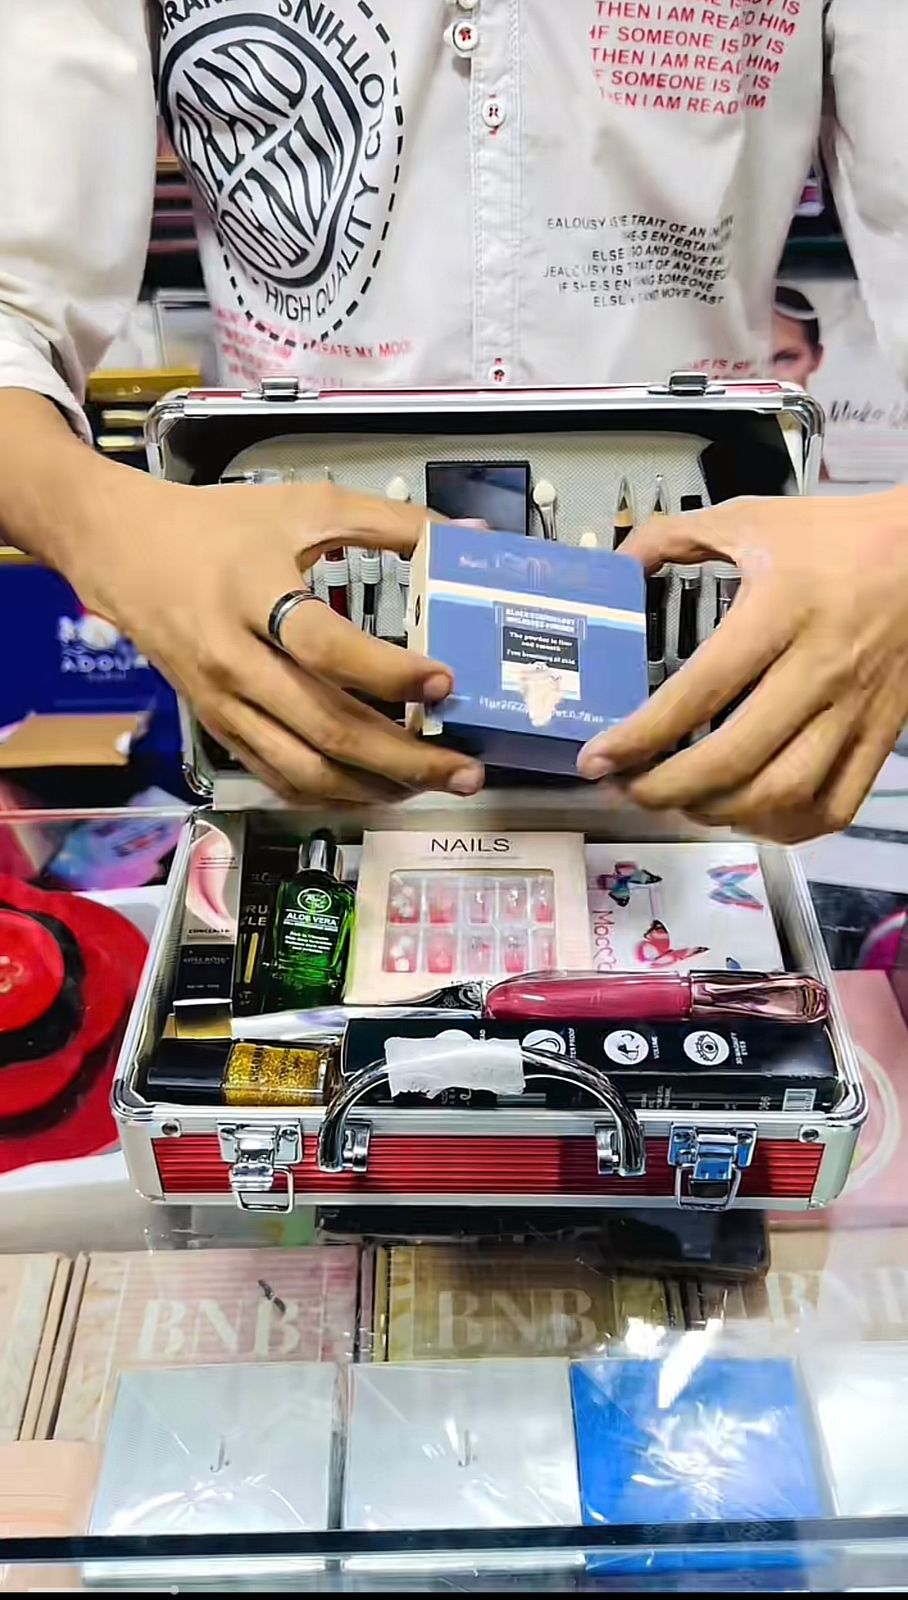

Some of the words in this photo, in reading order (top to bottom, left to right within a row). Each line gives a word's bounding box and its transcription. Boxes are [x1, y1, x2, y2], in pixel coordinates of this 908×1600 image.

[595, 0, 650, 19] THEN
[657, 5, 661, 20] I
[668, 6, 695, 22] AM
[759, 12, 795, 36] HIM
[618, 26, 713, 49] SOMEONE
[721, 38, 738, 53] IS
[766, 38, 784, 54] IS
[592, 48, 644, 66] THEN
[650, 52, 655, 67] I
[661, 53, 689, 69] AM
[746, 54, 779, 73] HIM
[611, 70, 705, 91] SOMEONE
[713, 78, 730, 93] IS
[753, 74, 771, 90] IS
[643, 94, 648, 107] I
[653, 95, 681, 109] AM
[631, 214, 666, 229] TRAIT
[669, 222, 686, 235] OF
[689, 226, 706, 238] AN
[265, 286, 311, 322] HIGH
[316, 173, 380, 317] QUALITY
[592, 248, 624, 262] ELSE
[645, 245, 669, 257] AND
[671, 248, 708, 266] MOVE
[611, 264, 624, 276] IS
[672, 262, 691, 273] AN
[658, 273, 715, 292] SOMEONE
[694, 291, 725, 305] FAST
[431, 838, 510, 853] NAILS
[286, 912, 311, 923] ALOE
[312, 916, 338, 927] VERA
[651, 1036, 660, 1059] VOLUME
[136, 1298, 301, 1361] BNB
[438, 1289, 597, 1350] BNB
